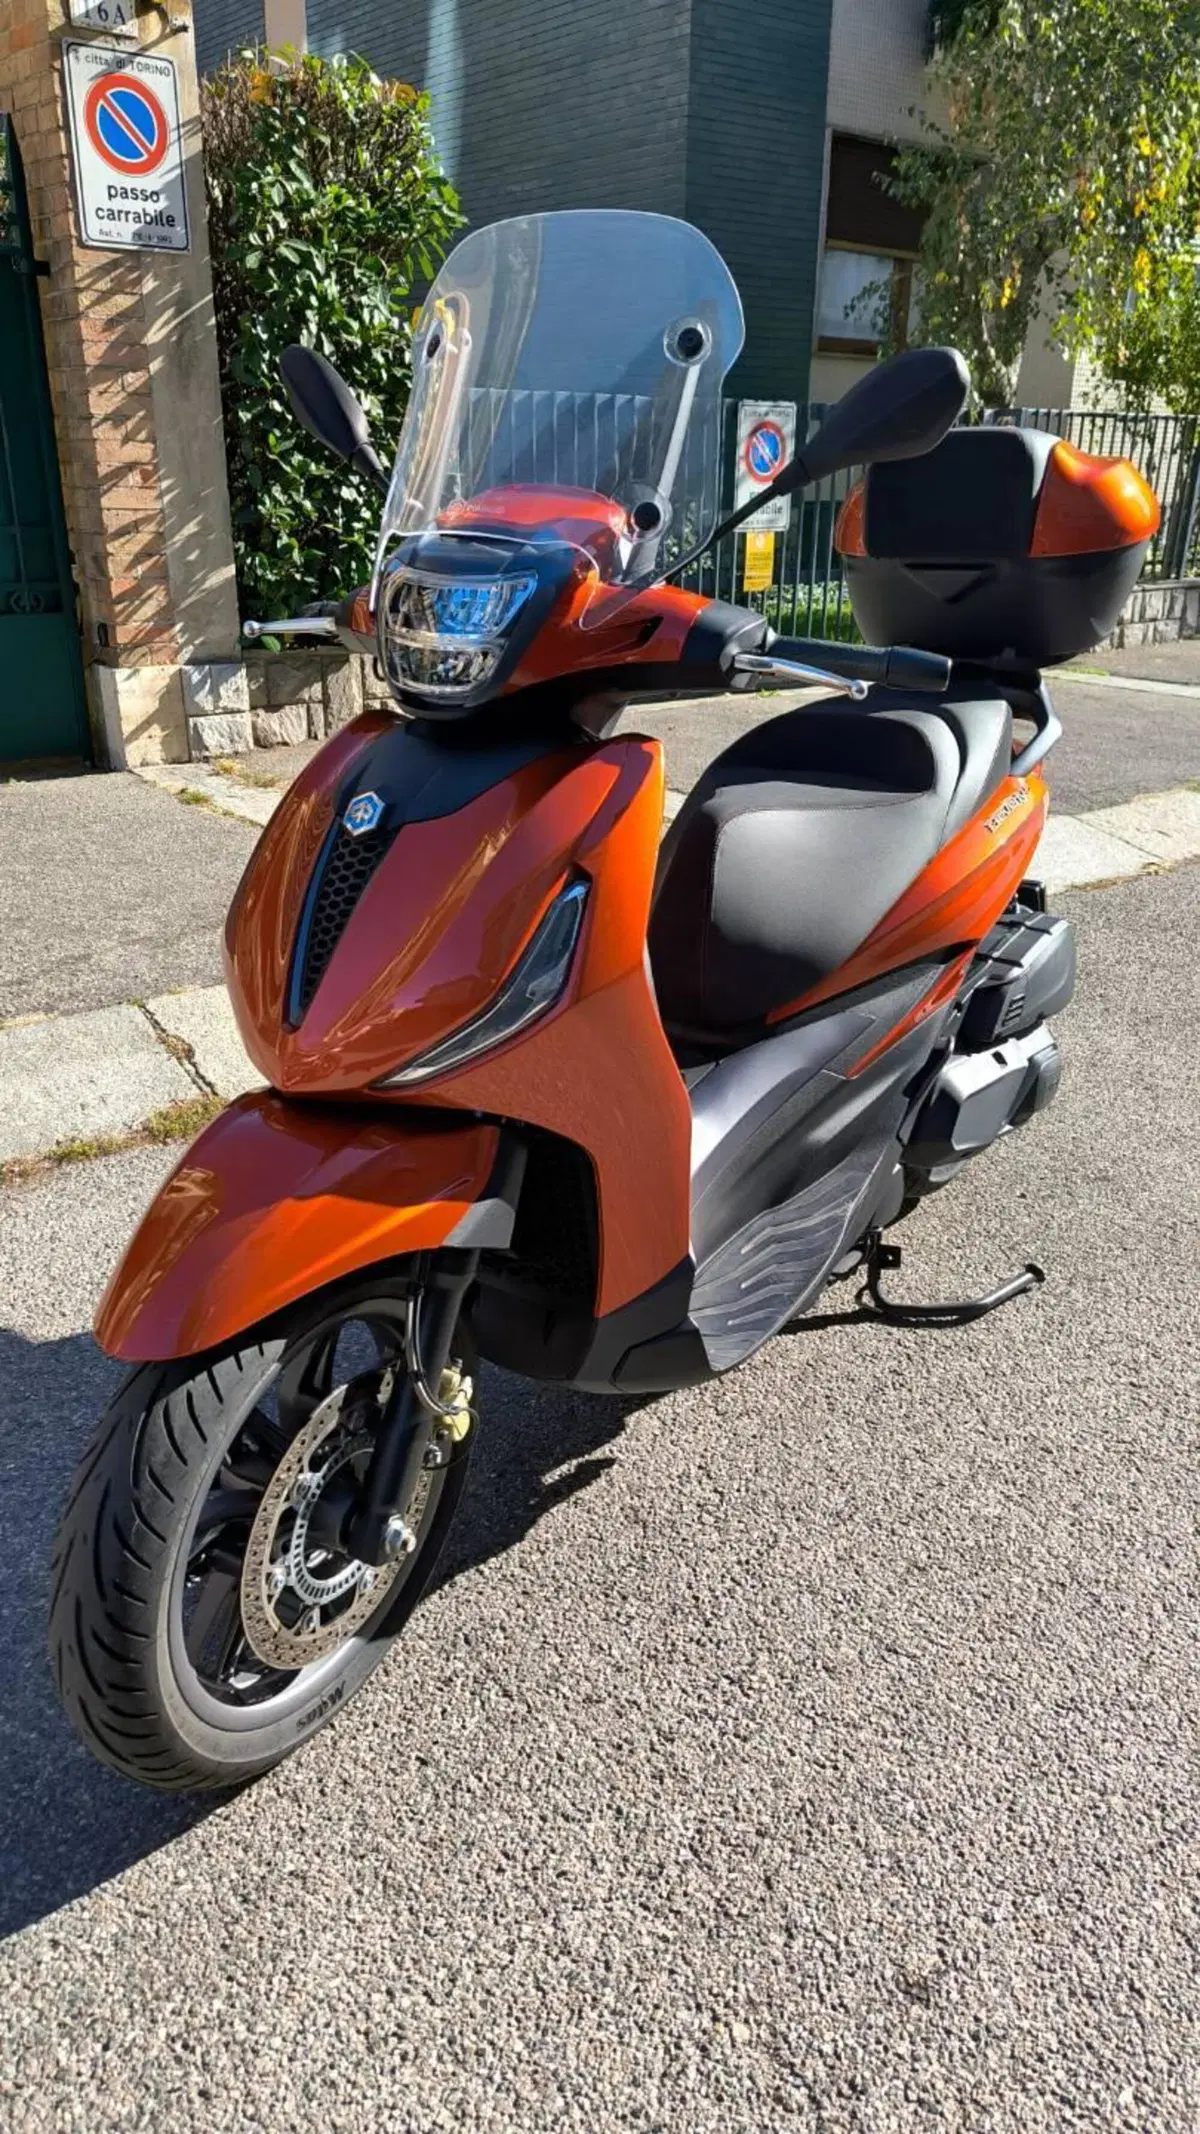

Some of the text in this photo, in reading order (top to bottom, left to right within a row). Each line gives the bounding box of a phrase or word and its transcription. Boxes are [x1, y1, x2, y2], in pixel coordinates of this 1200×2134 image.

[116, 58, 125, 69] di
[130, 60, 170, 77] TORINO
[107, 184, 160, 203] passo
[95, 206, 176, 228] carrabile
